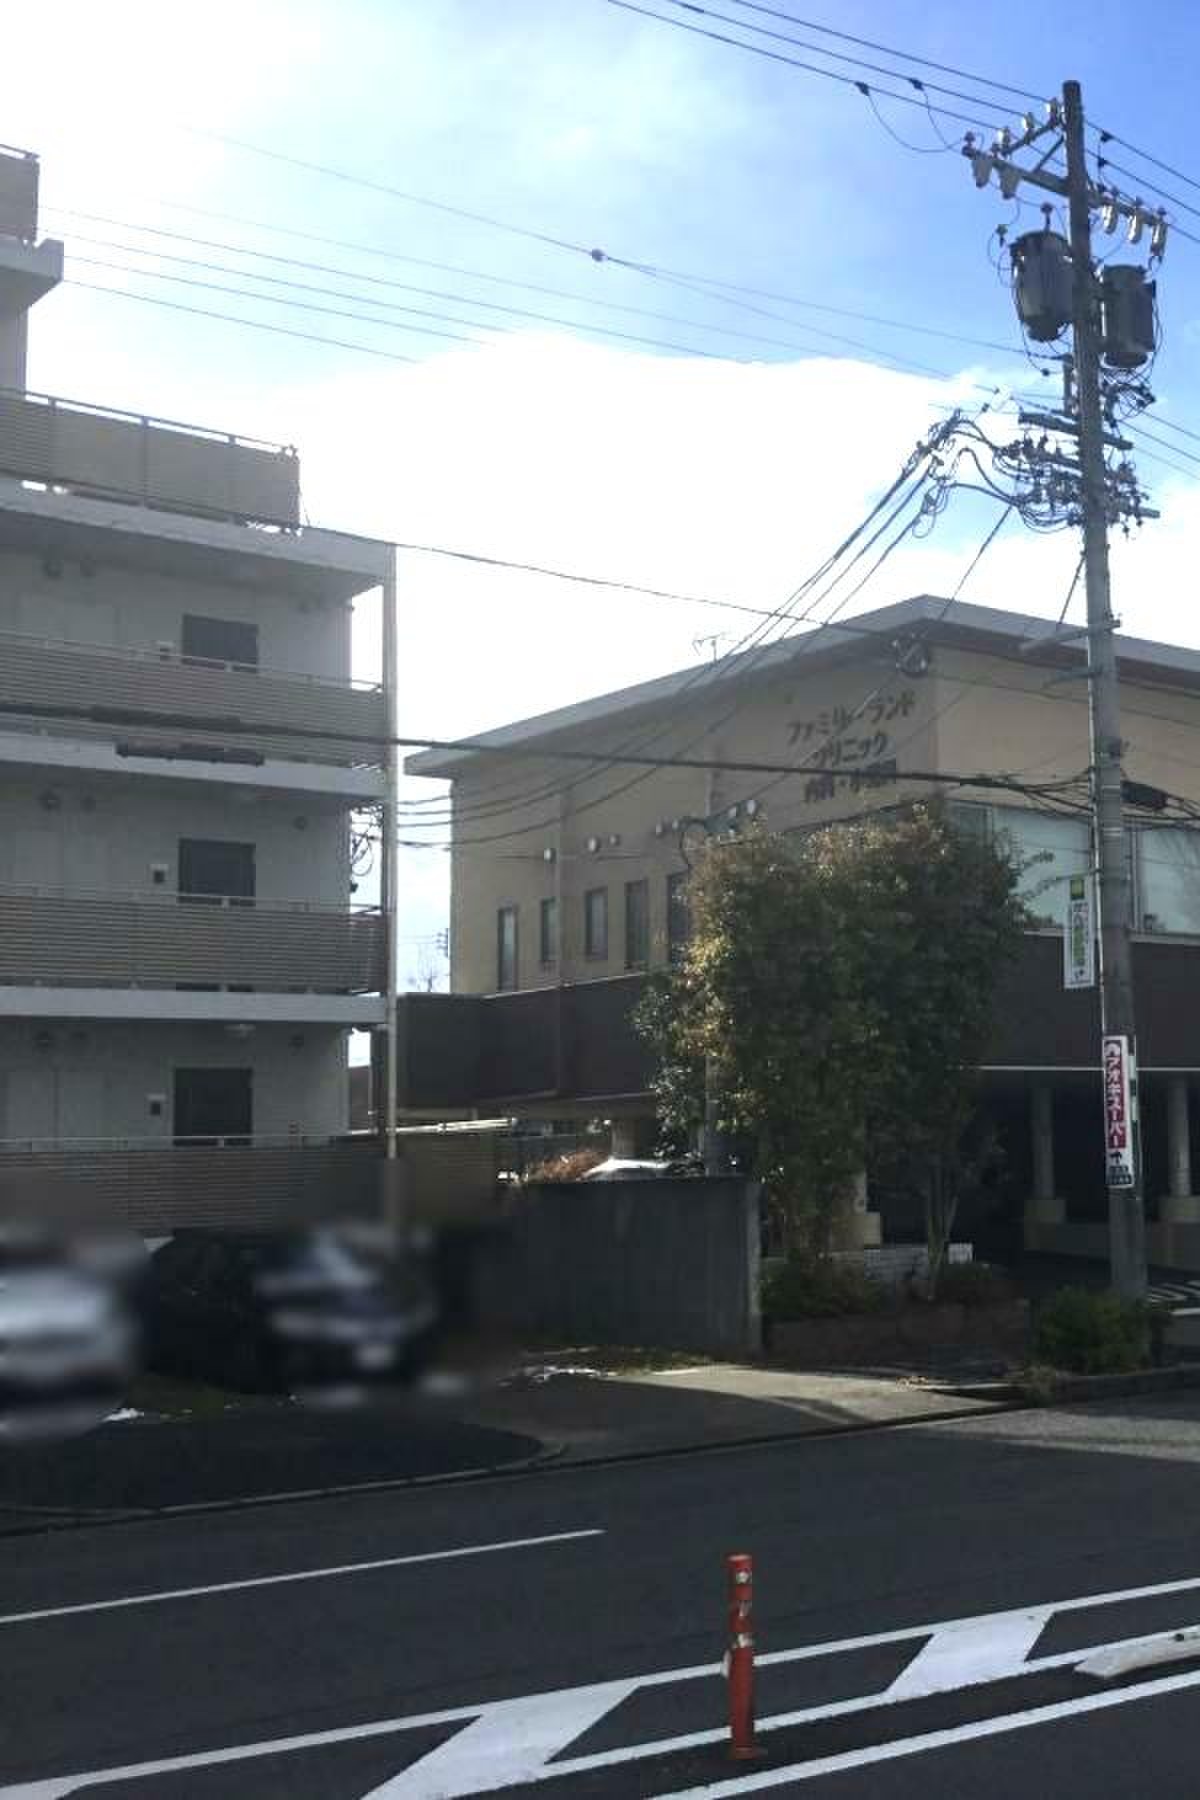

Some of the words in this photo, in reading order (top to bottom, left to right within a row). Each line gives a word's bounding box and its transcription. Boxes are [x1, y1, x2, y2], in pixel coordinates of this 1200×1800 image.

[1105, 1056, 1126, 1147] アオキスーパー
